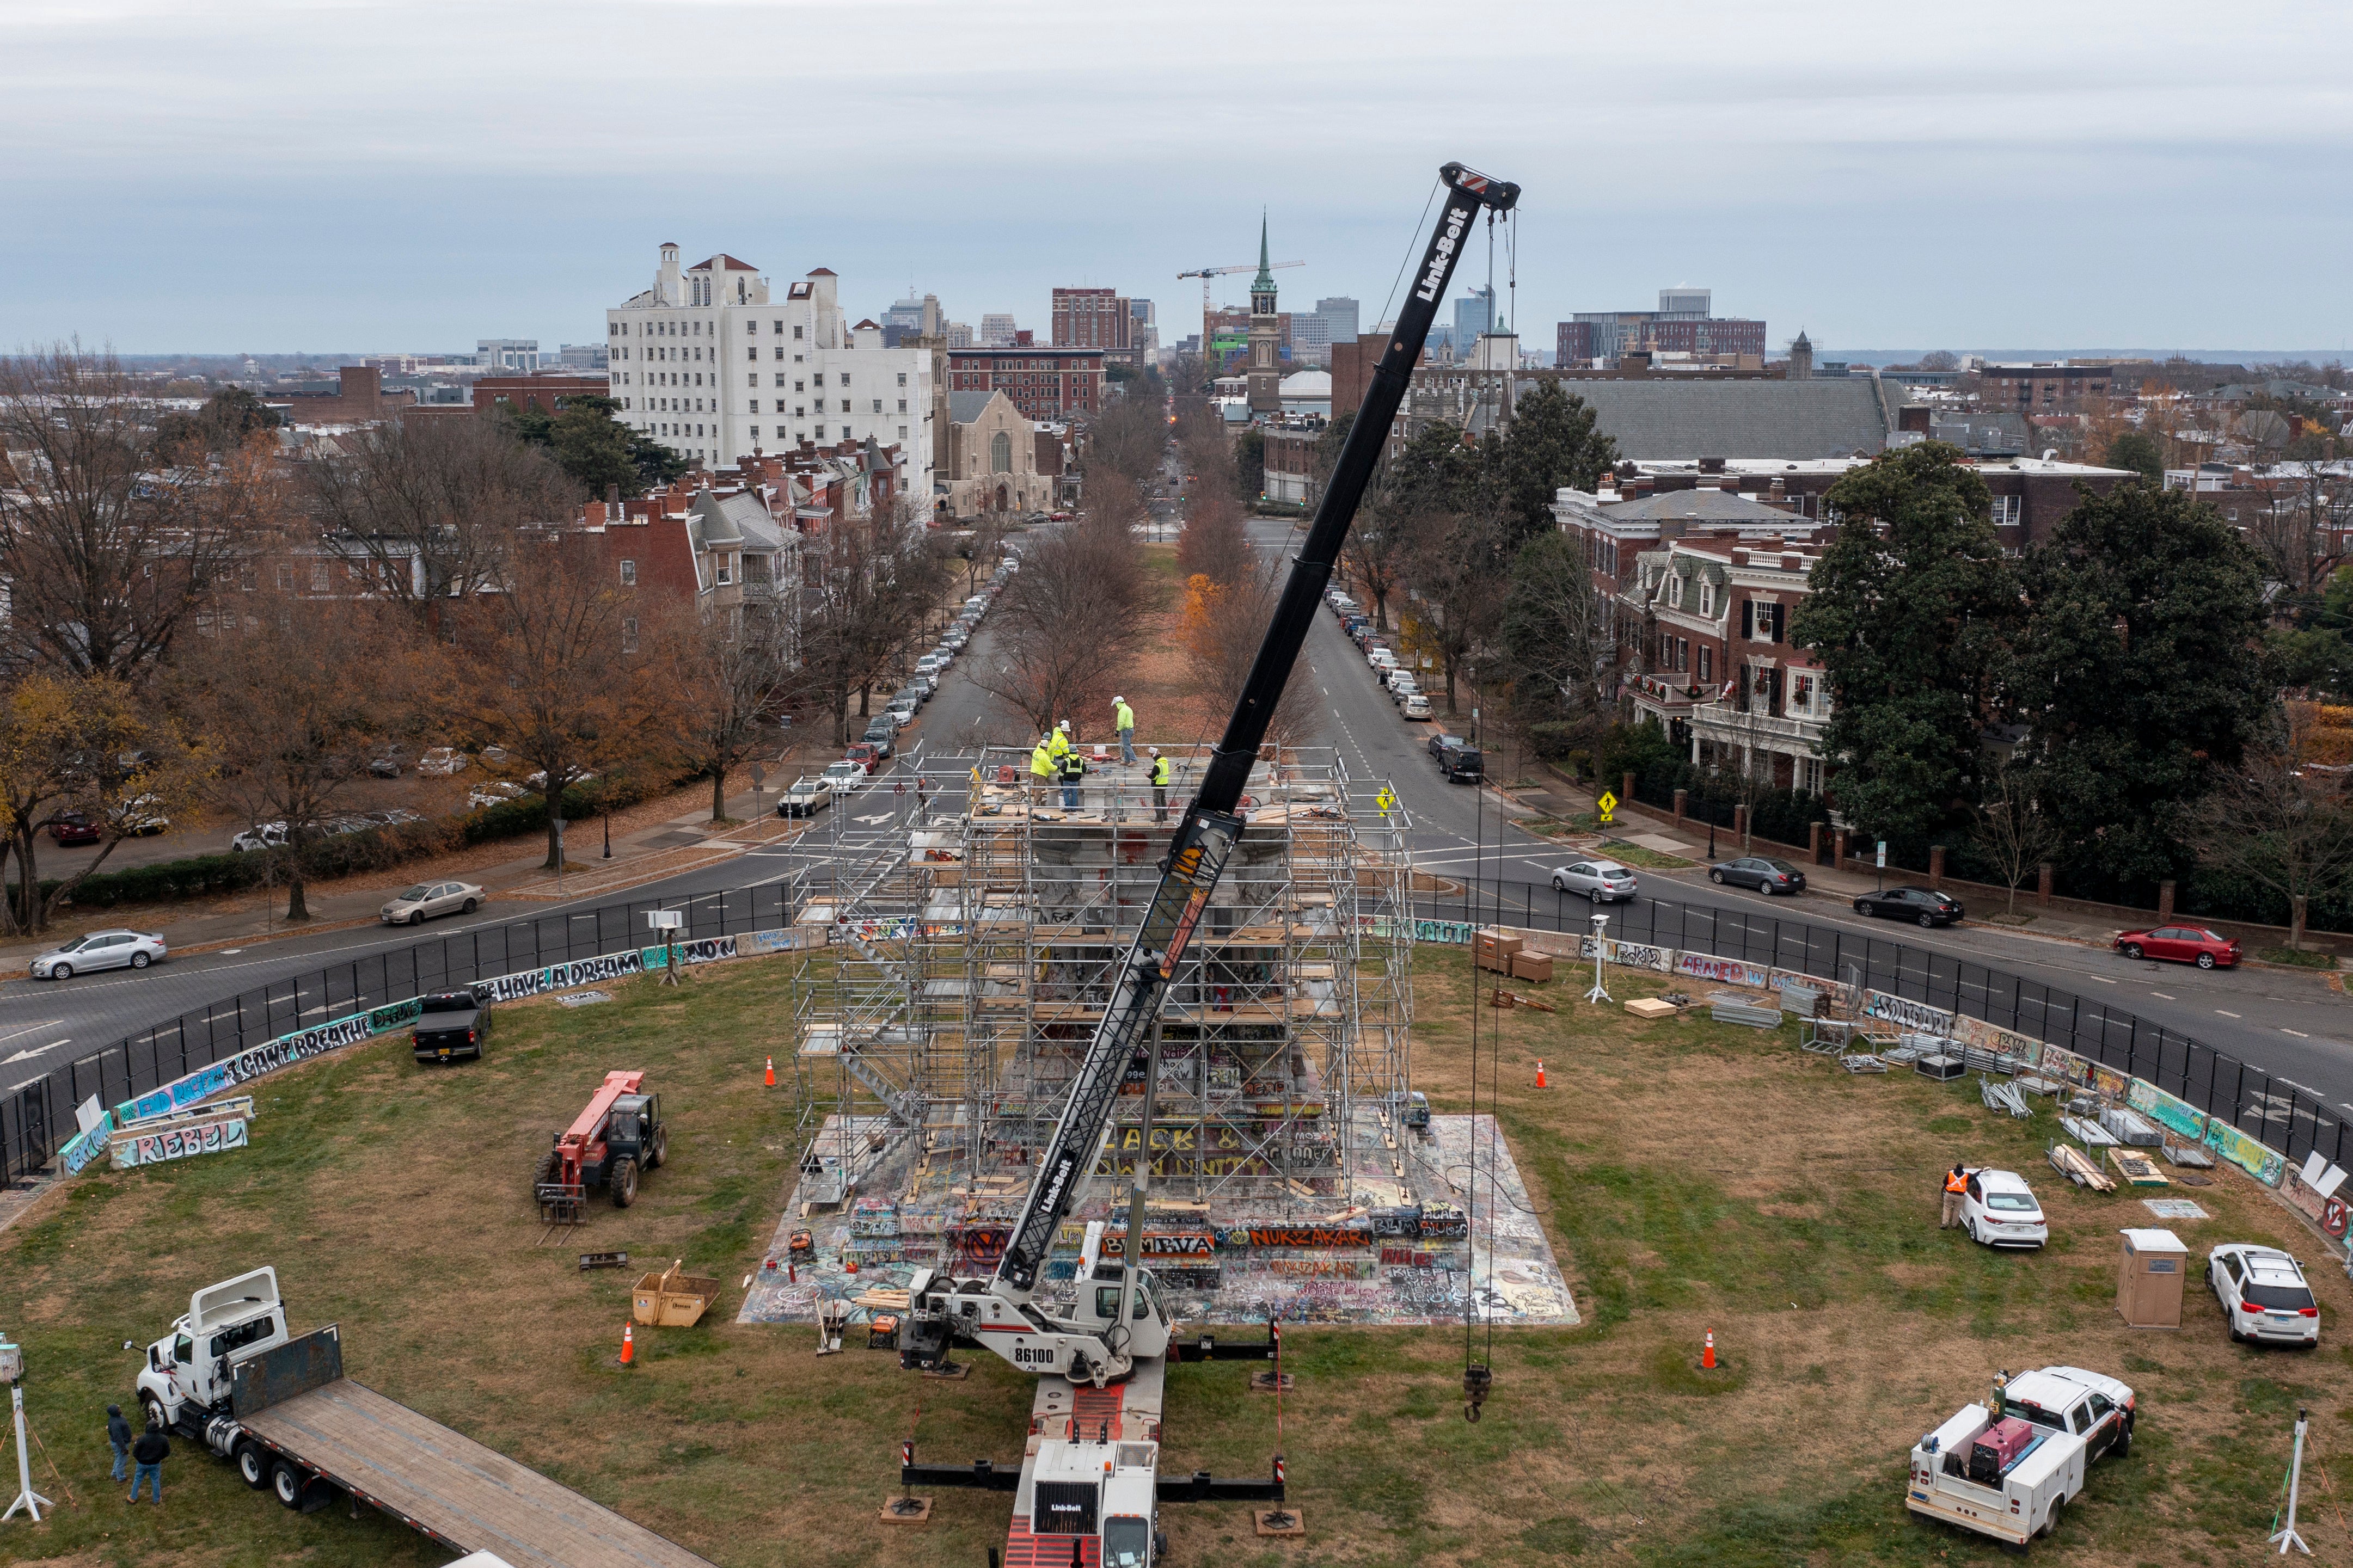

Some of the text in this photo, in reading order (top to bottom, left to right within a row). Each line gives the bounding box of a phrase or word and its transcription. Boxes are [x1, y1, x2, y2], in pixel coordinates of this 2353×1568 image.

[1417, 207, 1468, 302] Link-Belt
[495, 968, 549, 1001] HAVE
[549, 965, 570, 990] A
[568, 952, 644, 986] DREAM
[1680, 956, 1745, 983] ARMED
[290, 1014, 375, 1059] BREATHE
[137, 1065, 226, 1118] END RACISM
[137, 1119, 247, 1165] REBEL
[1095, 1128, 1196, 1151] LACK
[1176, 1157, 1265, 1177] UNITY
[1040, 1159, 1073, 1213] Link-Belt
[1155, 1235, 1214, 1253] RVA
[1390, 1267, 1444, 1277] KEEP
[1400, 1286, 1446, 1295] HEAD
[1015, 1348, 1054, 1363] 86100
